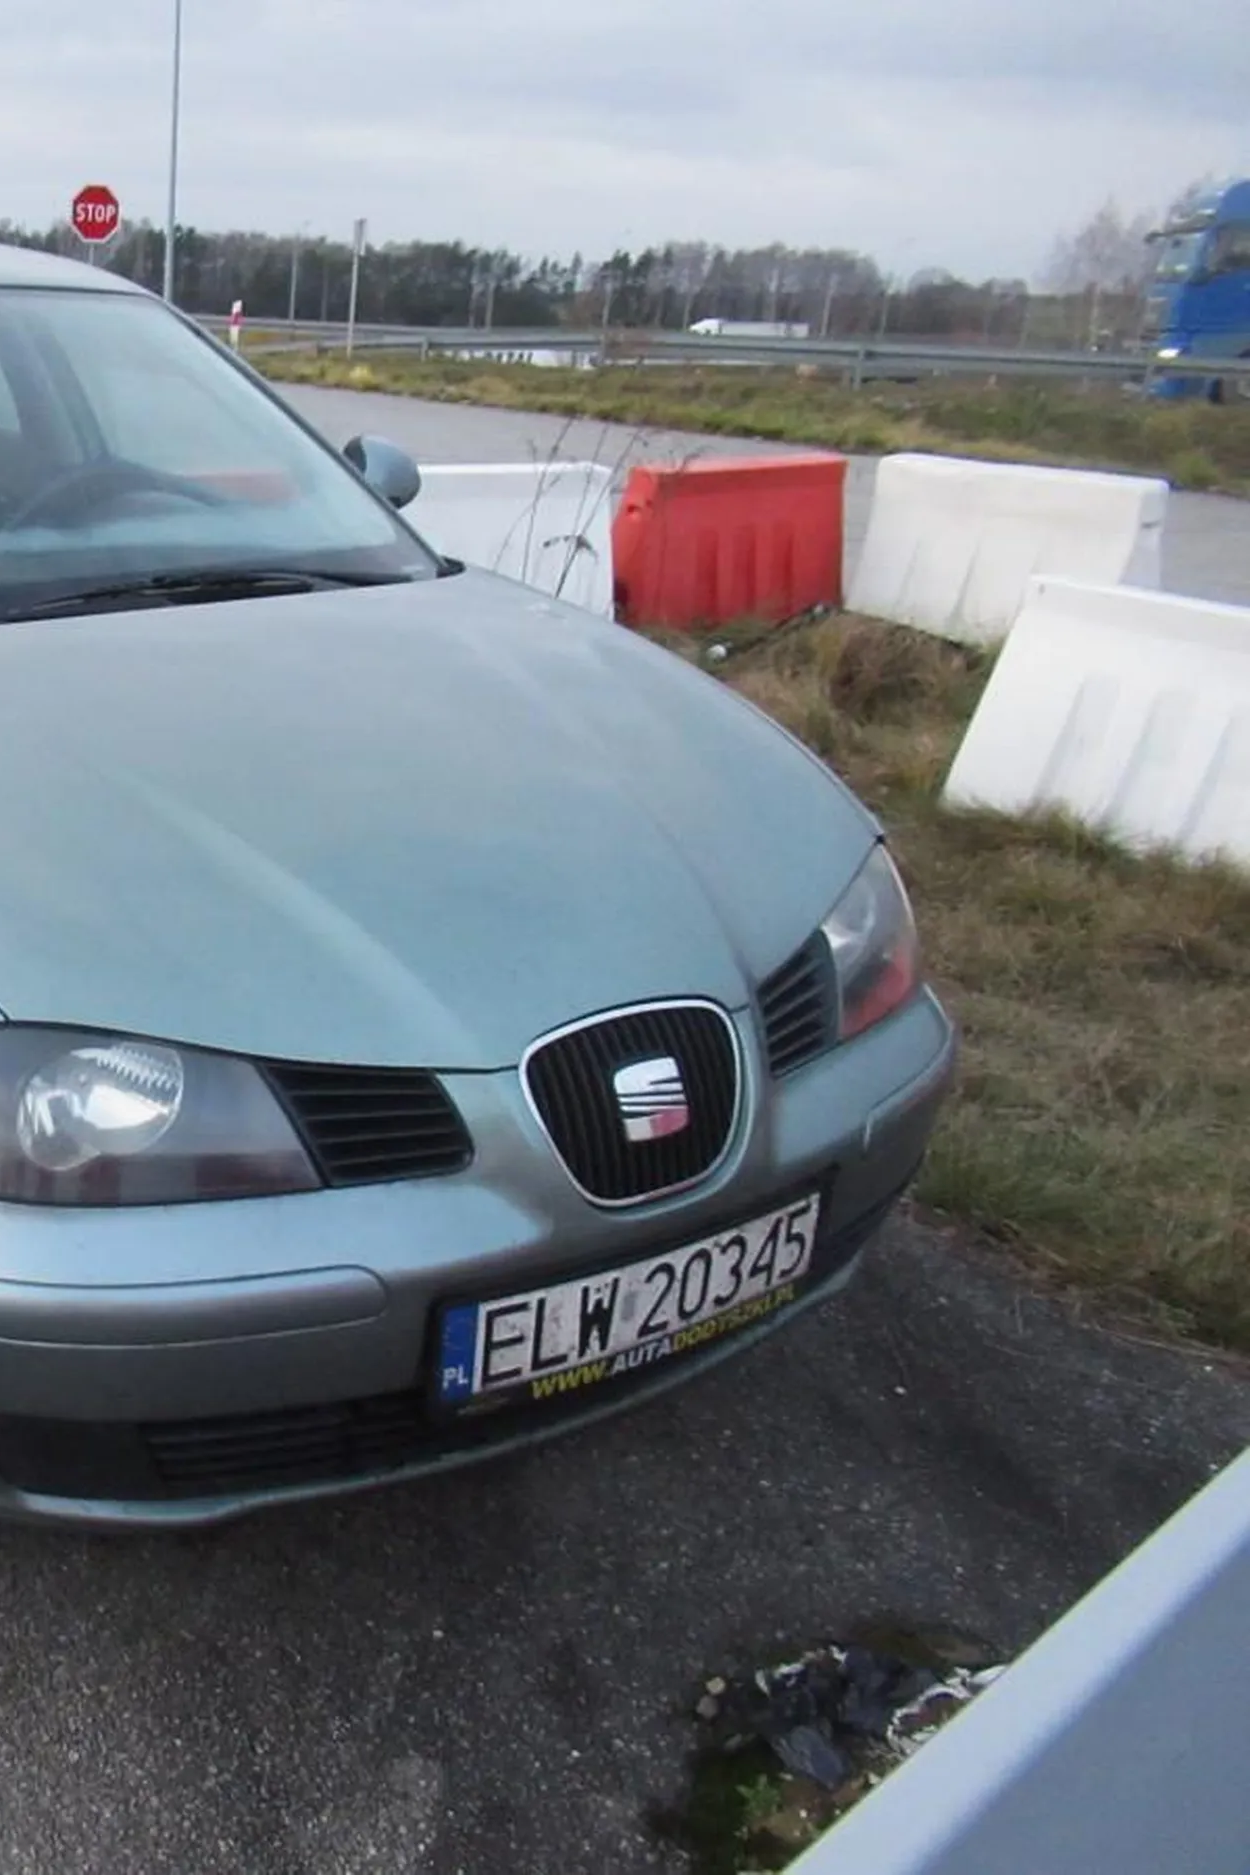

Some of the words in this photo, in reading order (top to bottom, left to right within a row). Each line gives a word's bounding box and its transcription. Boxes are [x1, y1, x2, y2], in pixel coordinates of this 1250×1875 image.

[75, 202, 116, 223] STOP
[480, 1277, 618, 1388] ELW
[637, 1200, 812, 1340] 20345
[442, 1364, 469, 1390] PL
